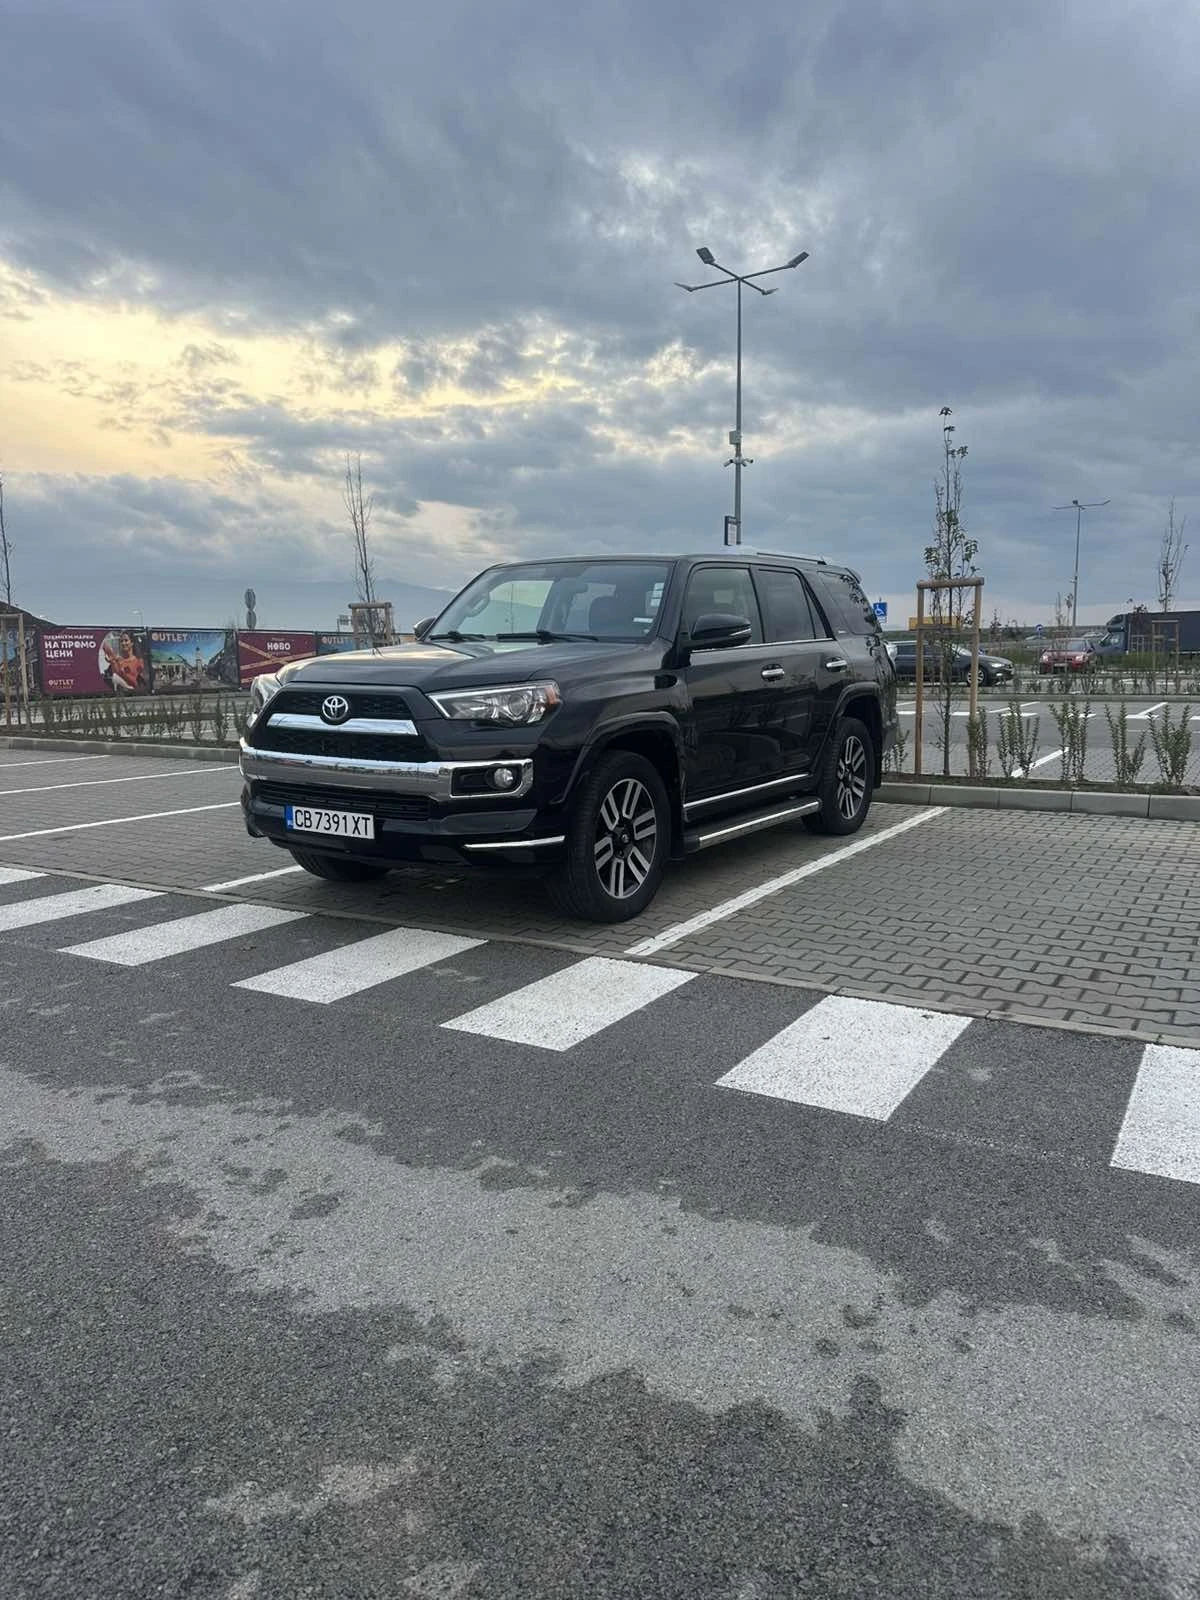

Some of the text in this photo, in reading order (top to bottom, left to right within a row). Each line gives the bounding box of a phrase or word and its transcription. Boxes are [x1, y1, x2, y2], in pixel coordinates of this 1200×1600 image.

[151, 632, 187, 642] OUTLET
[44, 641, 97, 649] НА ПРОМО
[45, 649, 73, 659] ЦЕНИ
